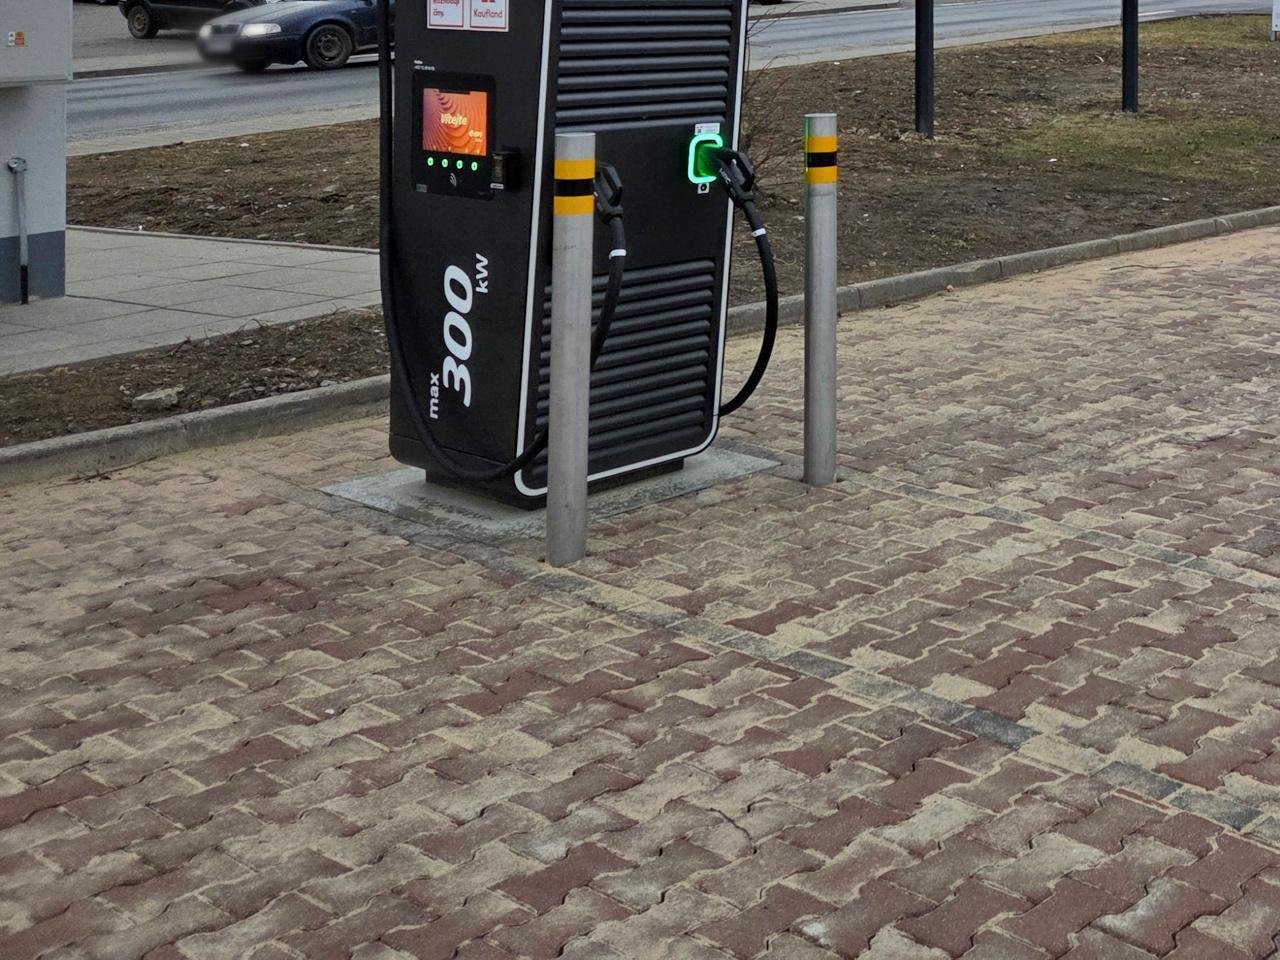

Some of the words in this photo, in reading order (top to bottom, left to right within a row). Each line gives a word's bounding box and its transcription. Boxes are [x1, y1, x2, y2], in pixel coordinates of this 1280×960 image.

[473, 8, 503, 19] Kaufland
[429, 372, 440, 419] max
[442, 265, 473, 408] 300
[475, 253, 489, 293] kW
